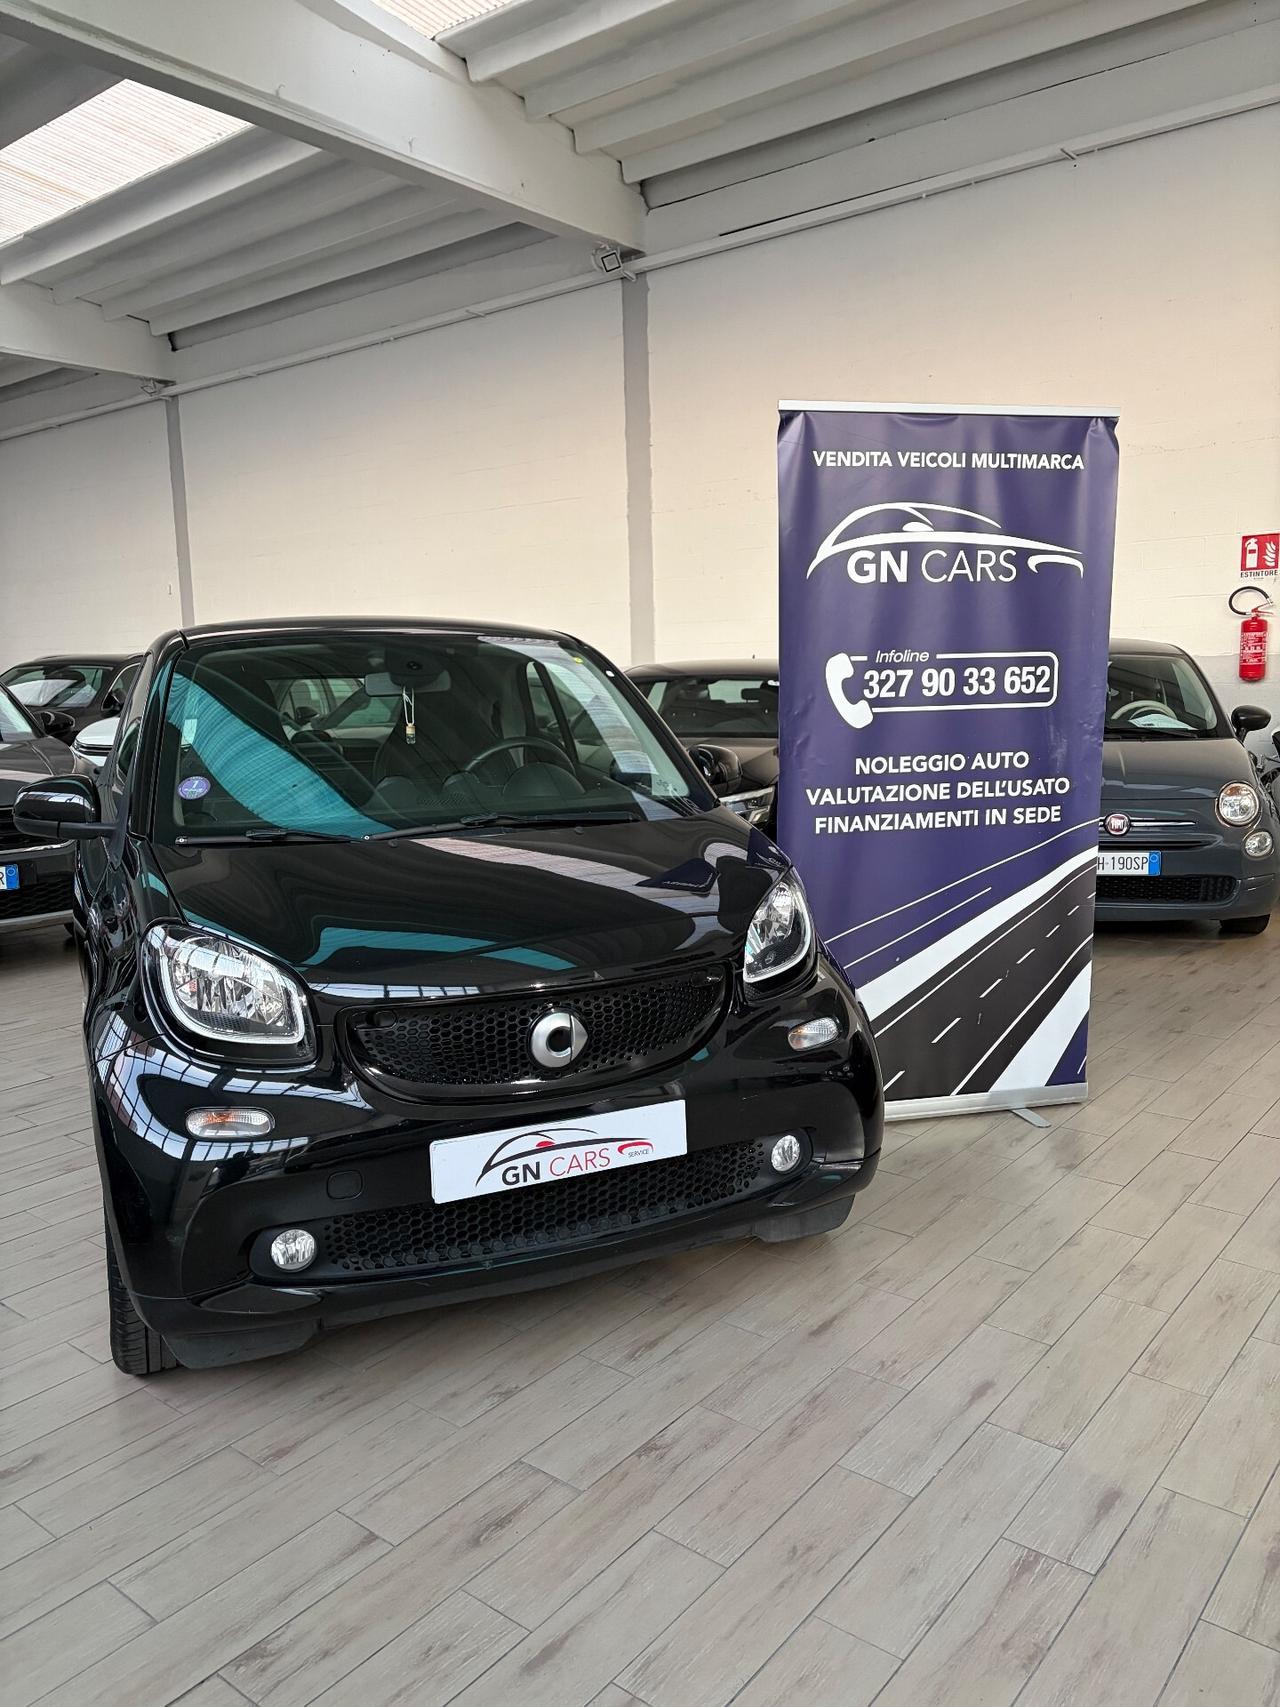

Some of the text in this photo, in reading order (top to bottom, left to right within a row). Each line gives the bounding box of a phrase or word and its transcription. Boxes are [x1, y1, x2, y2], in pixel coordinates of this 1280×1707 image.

[813, 451, 1085, 470] VENDITA VEICOLI MULTIMARCA
[847, 549, 1017, 584] GN CARS
[1240, 570, 1278, 578] ESTINTORE
[875, 649, 930, 664] Infoline
[863, 665, 1050, 699] 327 90 33 652
[855, 751, 1030, 776] NOLEGGIO AUTO
[806, 777, 1070, 806] VALUTAZIONE DELL'USATO
[815, 805, 1062, 834] FINANZIAMENTI IN SEDE
[501, 1161, 541, 1186] GN
[549, 1147, 611, 1177] CARS
